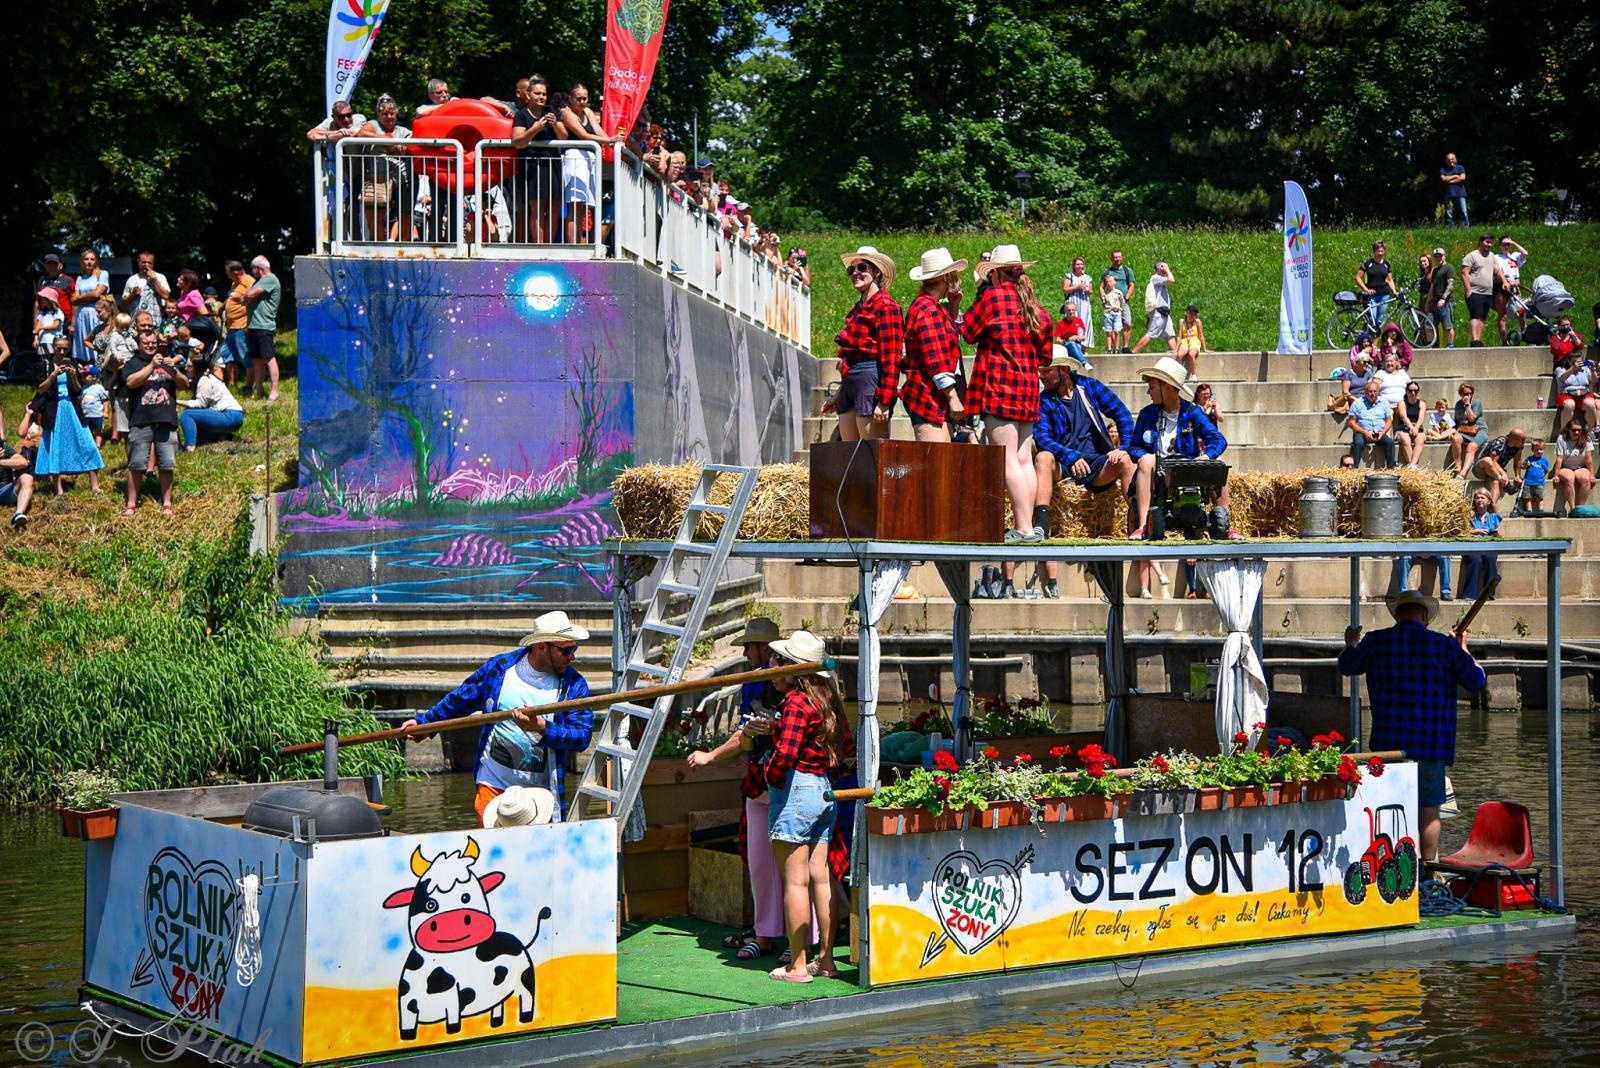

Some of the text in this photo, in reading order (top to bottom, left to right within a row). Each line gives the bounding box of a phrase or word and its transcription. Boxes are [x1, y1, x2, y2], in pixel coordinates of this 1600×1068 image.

[942, 865, 1003, 905] ROLNIK
[1070, 828, 1324, 904] SEZON 12
[148, 864, 237, 937] ROLNIK
[941, 885, 997, 925] SZUKA
[945, 907, 992, 941] ŻONY
[1068, 908, 1088, 939] Nie
[1186, 912, 1199, 929] się
[154, 914, 228, 985] SZUKA
[170, 963, 226, 1023] ŻONY
